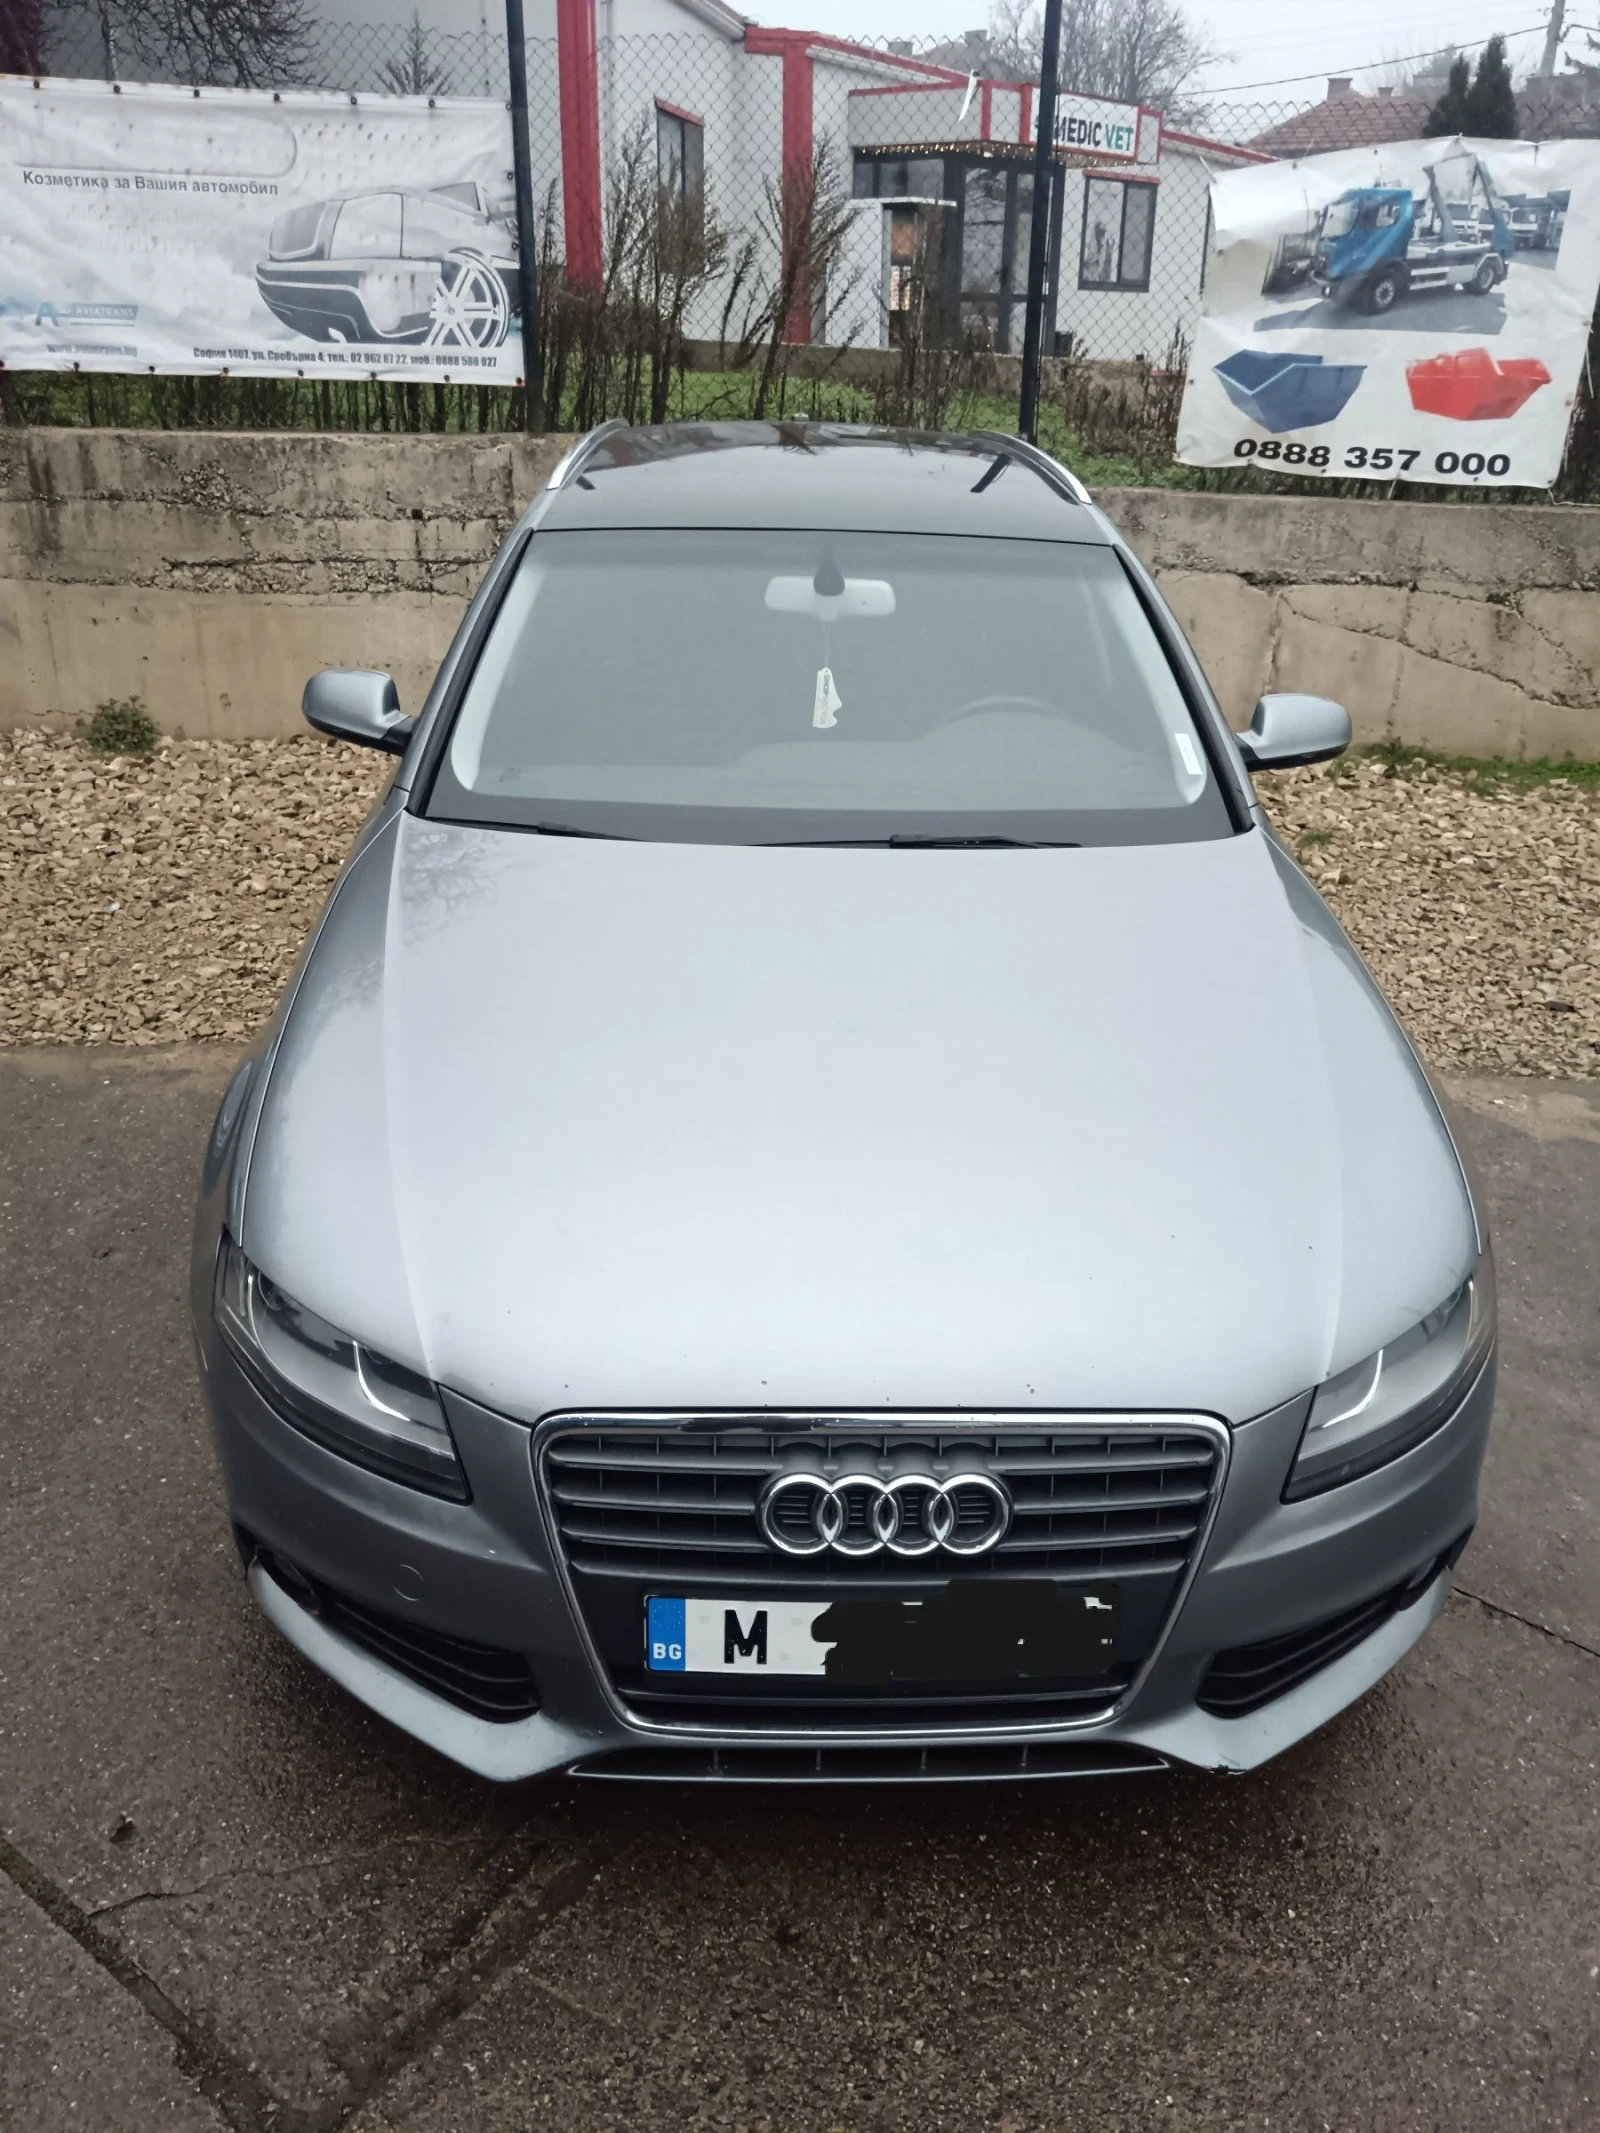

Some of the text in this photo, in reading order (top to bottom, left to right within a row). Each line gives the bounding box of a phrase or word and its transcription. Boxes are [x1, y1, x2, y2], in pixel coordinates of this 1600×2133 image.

[1052, 115, 1134, 151] MEDIC VET
[23, 170, 279, 196] Козметика за Вашия автомобил
[75, 305, 135, 317] AVIATRANS
[193, 347, 227, 360] София
[350, 353, 362, 363] 02
[364, 353, 381, 364] 962
[436, 355, 459, 366] 0888
[1233, 438, 1511, 476] 0888 357 000
[724, 1609, 768, 1665] M
[653, 1643, 682, 1660] BG
